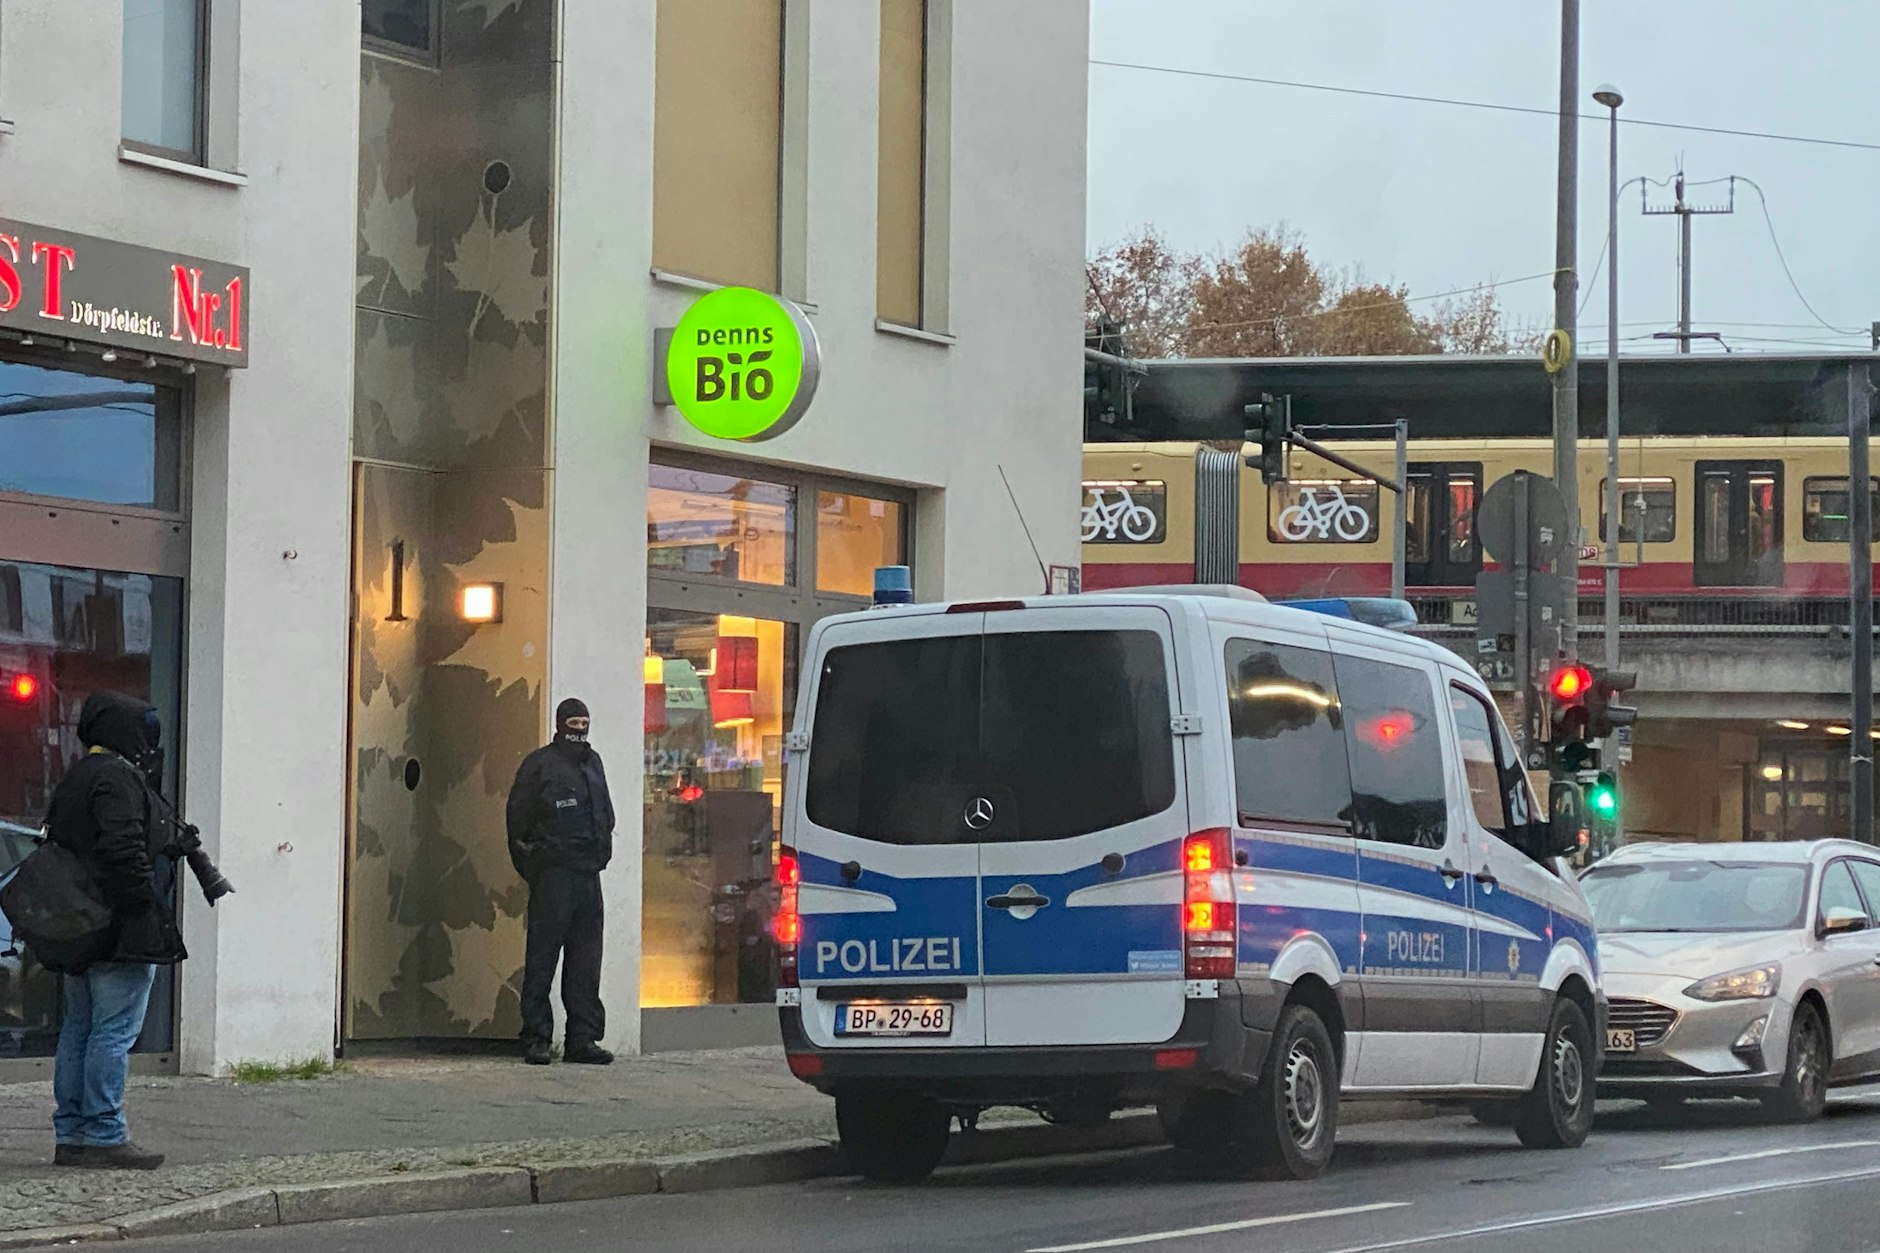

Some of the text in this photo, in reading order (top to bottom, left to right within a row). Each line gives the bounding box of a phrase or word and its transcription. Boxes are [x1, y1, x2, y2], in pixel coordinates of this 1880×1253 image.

[70, 300, 163, 338] Dörpfeldstr.
[696, 350, 774, 402] Bio
[816, 936, 961, 974] POLIZEI
[1388, 930, 1445, 963] POLIZEI
[852, 1008, 944, 1029] BP 29-68
